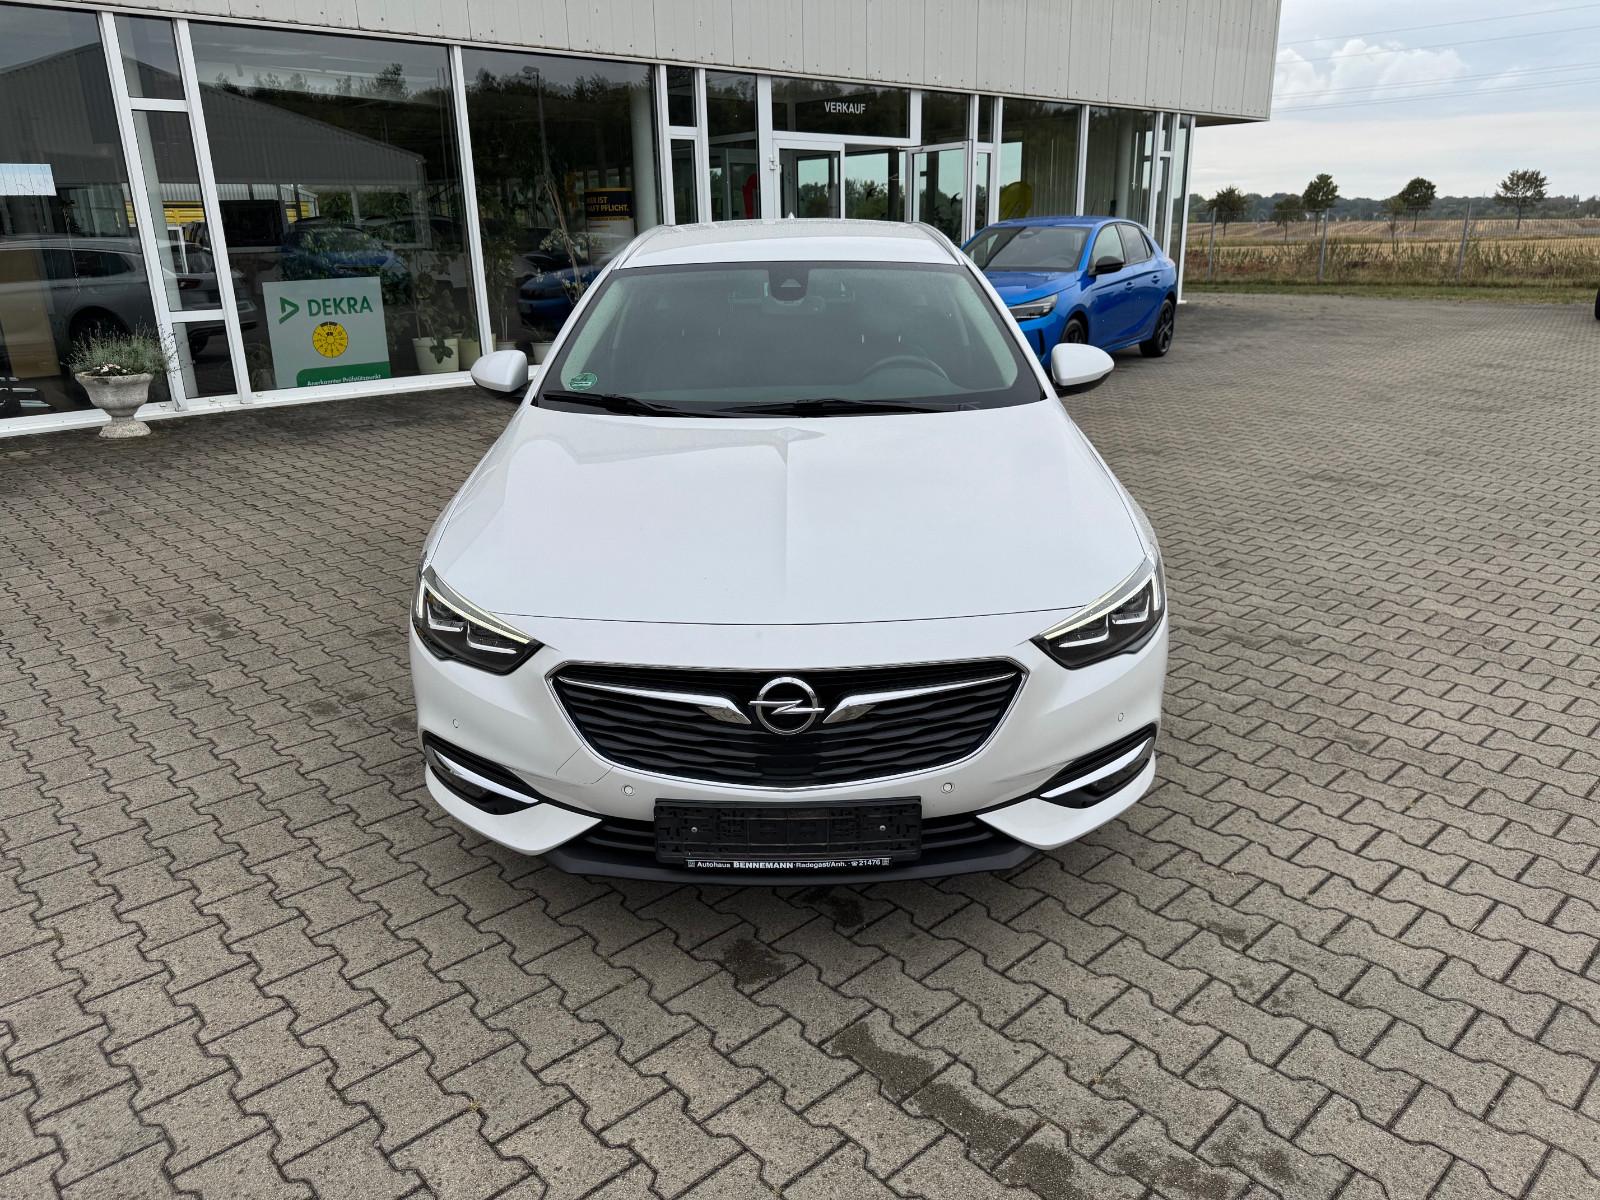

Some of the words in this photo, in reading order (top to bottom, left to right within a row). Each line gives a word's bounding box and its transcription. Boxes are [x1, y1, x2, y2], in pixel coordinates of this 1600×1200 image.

[824, 101, 867, 114] VERKAUF
[307, 295, 374, 317] DEKRA
[733, 861, 794, 869] BENNEMANN
